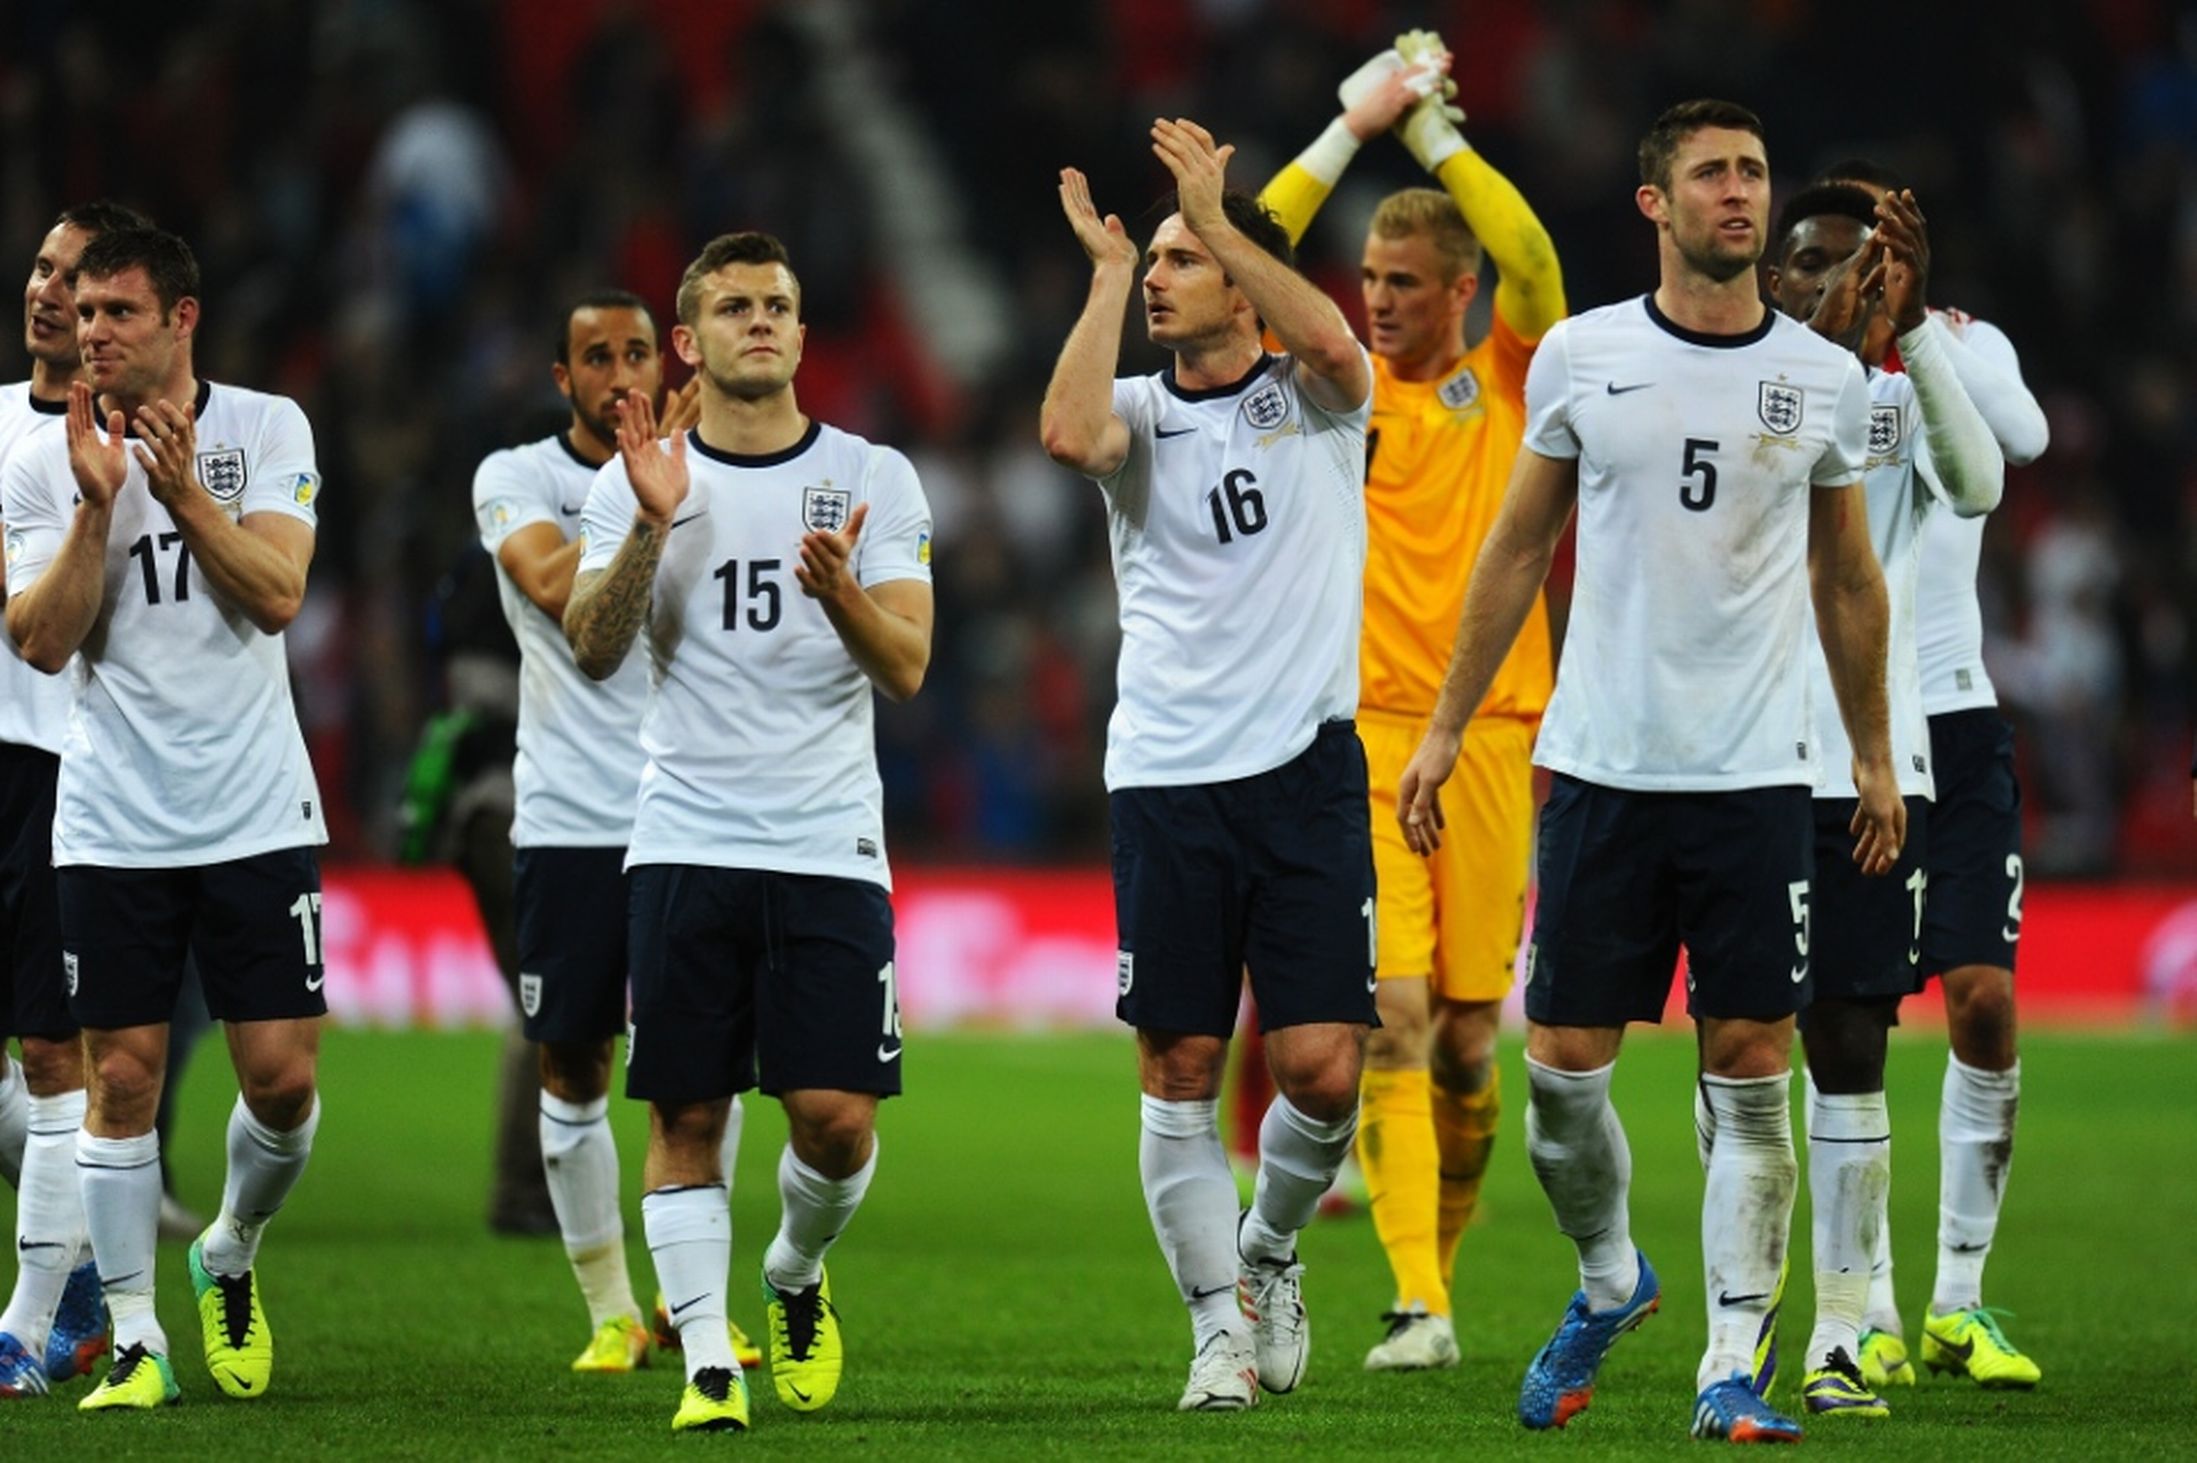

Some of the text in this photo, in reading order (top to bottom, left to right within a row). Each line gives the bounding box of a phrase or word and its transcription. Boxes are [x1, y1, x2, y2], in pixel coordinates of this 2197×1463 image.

[1205, 468, 1268, 544] 16
[1679, 438, 1720, 512] 5
[129, 531, 189, 606] 17
[713, 558, 781, 632] 15
[1788, 880, 1809, 956] 5
[1905, 867, 1928, 940] 1
